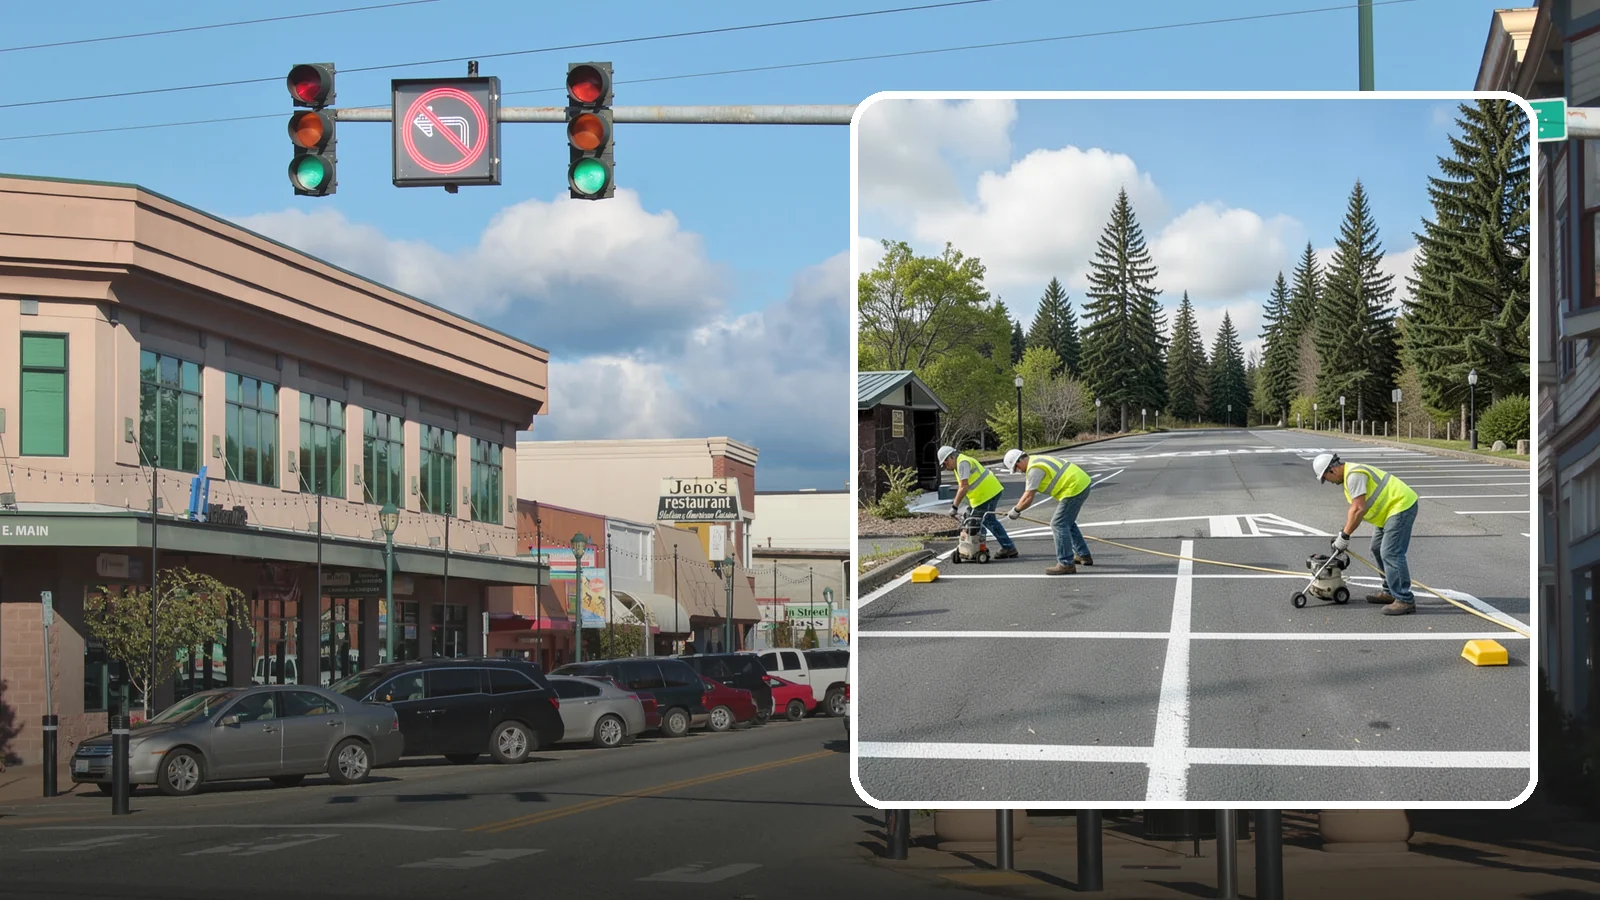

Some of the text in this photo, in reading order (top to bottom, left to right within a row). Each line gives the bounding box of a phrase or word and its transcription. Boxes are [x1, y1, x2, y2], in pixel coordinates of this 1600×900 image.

[670, 480, 727, 495] Jeno's
[665, 496, 731, 509] restaurant
[658, 509, 681, 520] Italian
[686, 509, 715, 519] American
[715, 509, 738, 519] Cuisine
[2, 525, 49, 536] E. MAIN
[797, 608, 828, 617] Street
[790, 619, 824, 627] lass
